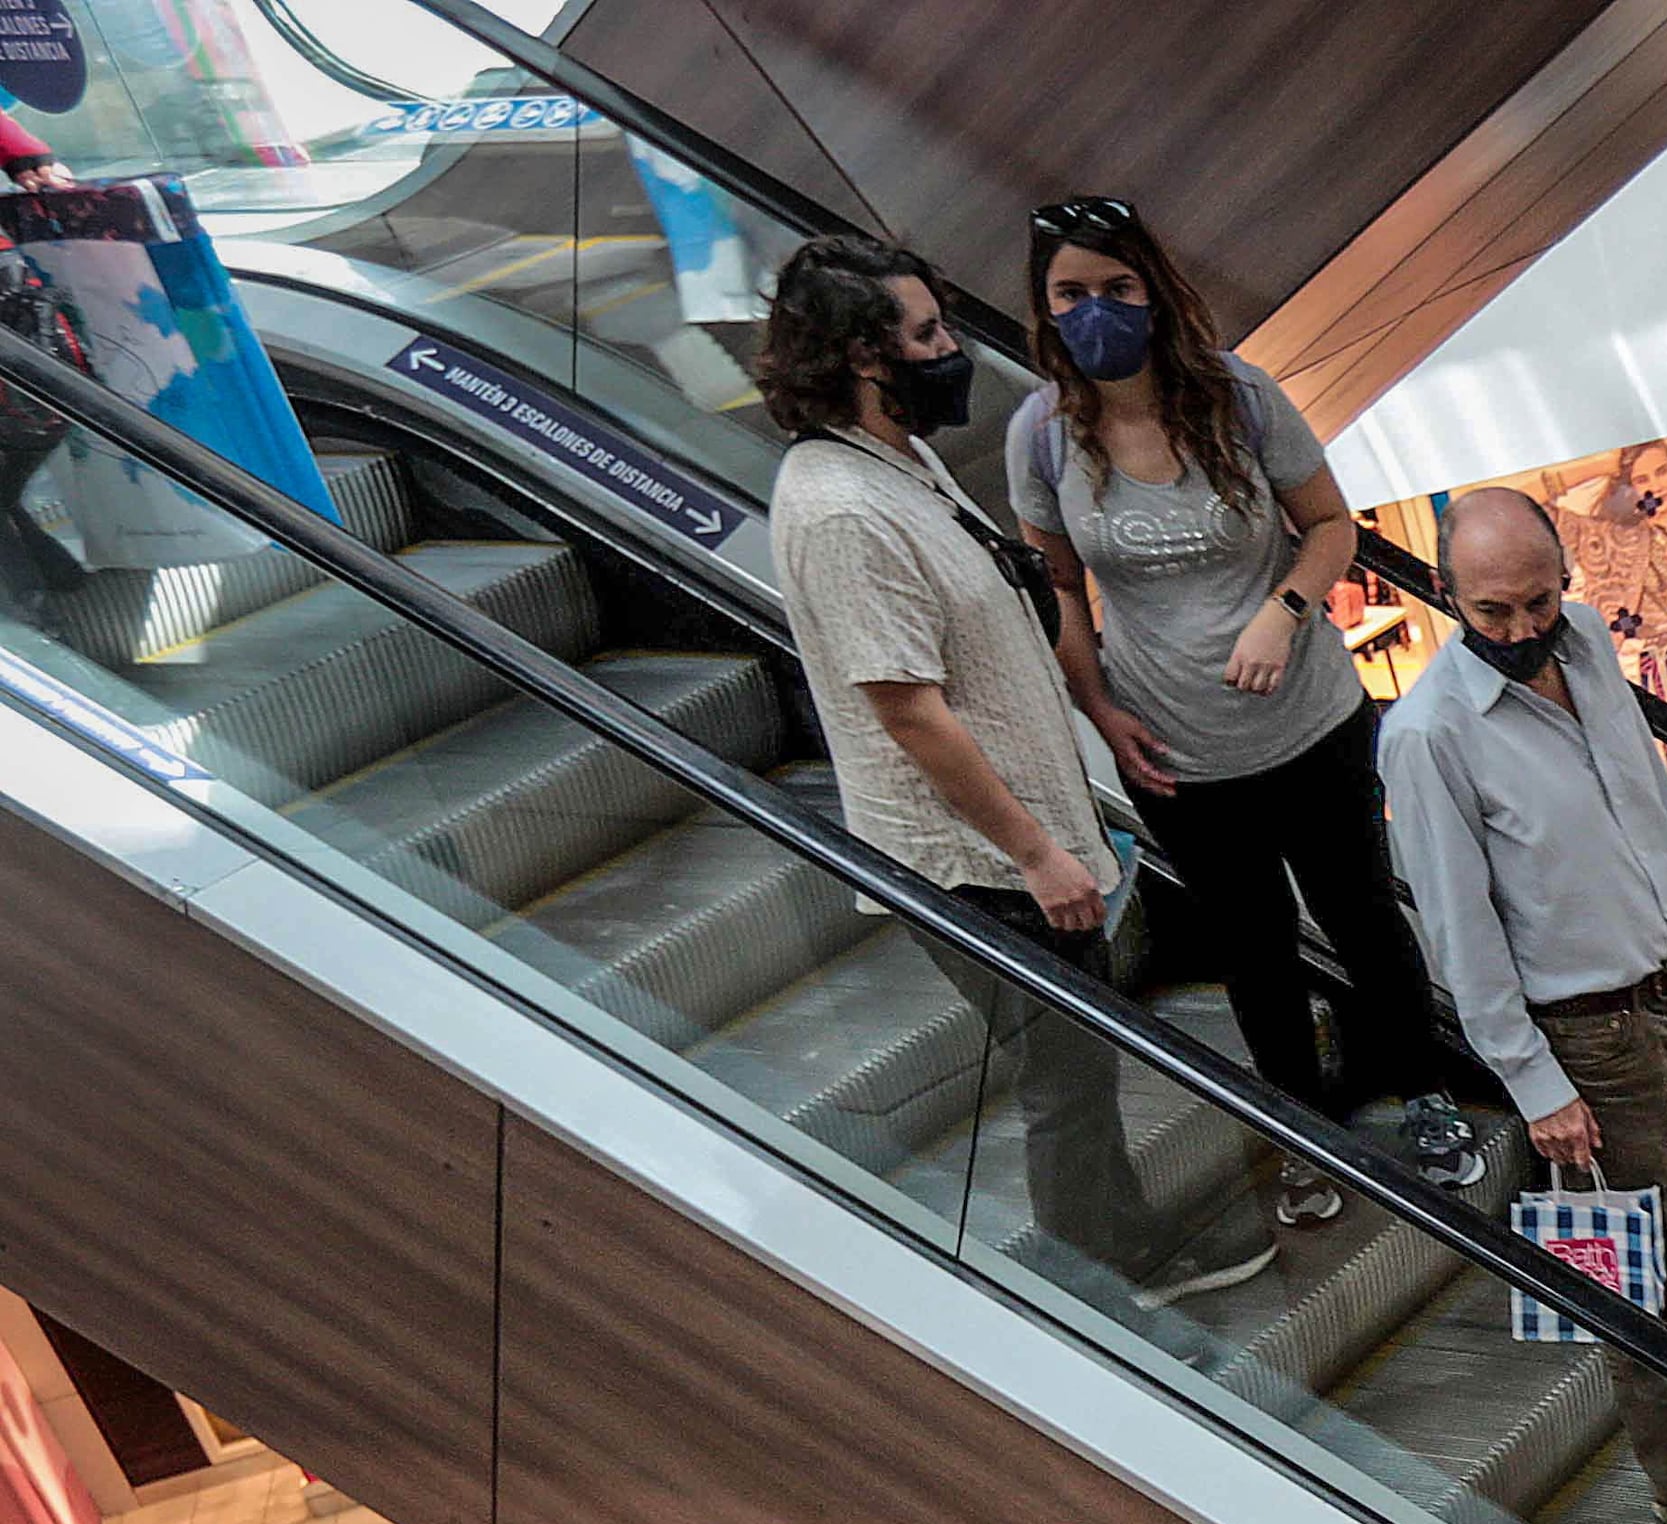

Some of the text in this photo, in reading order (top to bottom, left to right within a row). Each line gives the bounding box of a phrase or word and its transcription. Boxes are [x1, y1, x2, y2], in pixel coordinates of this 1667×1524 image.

[445, 366, 684, 511] MANTÉN 3 ESCALONES DE DISTANCIA
